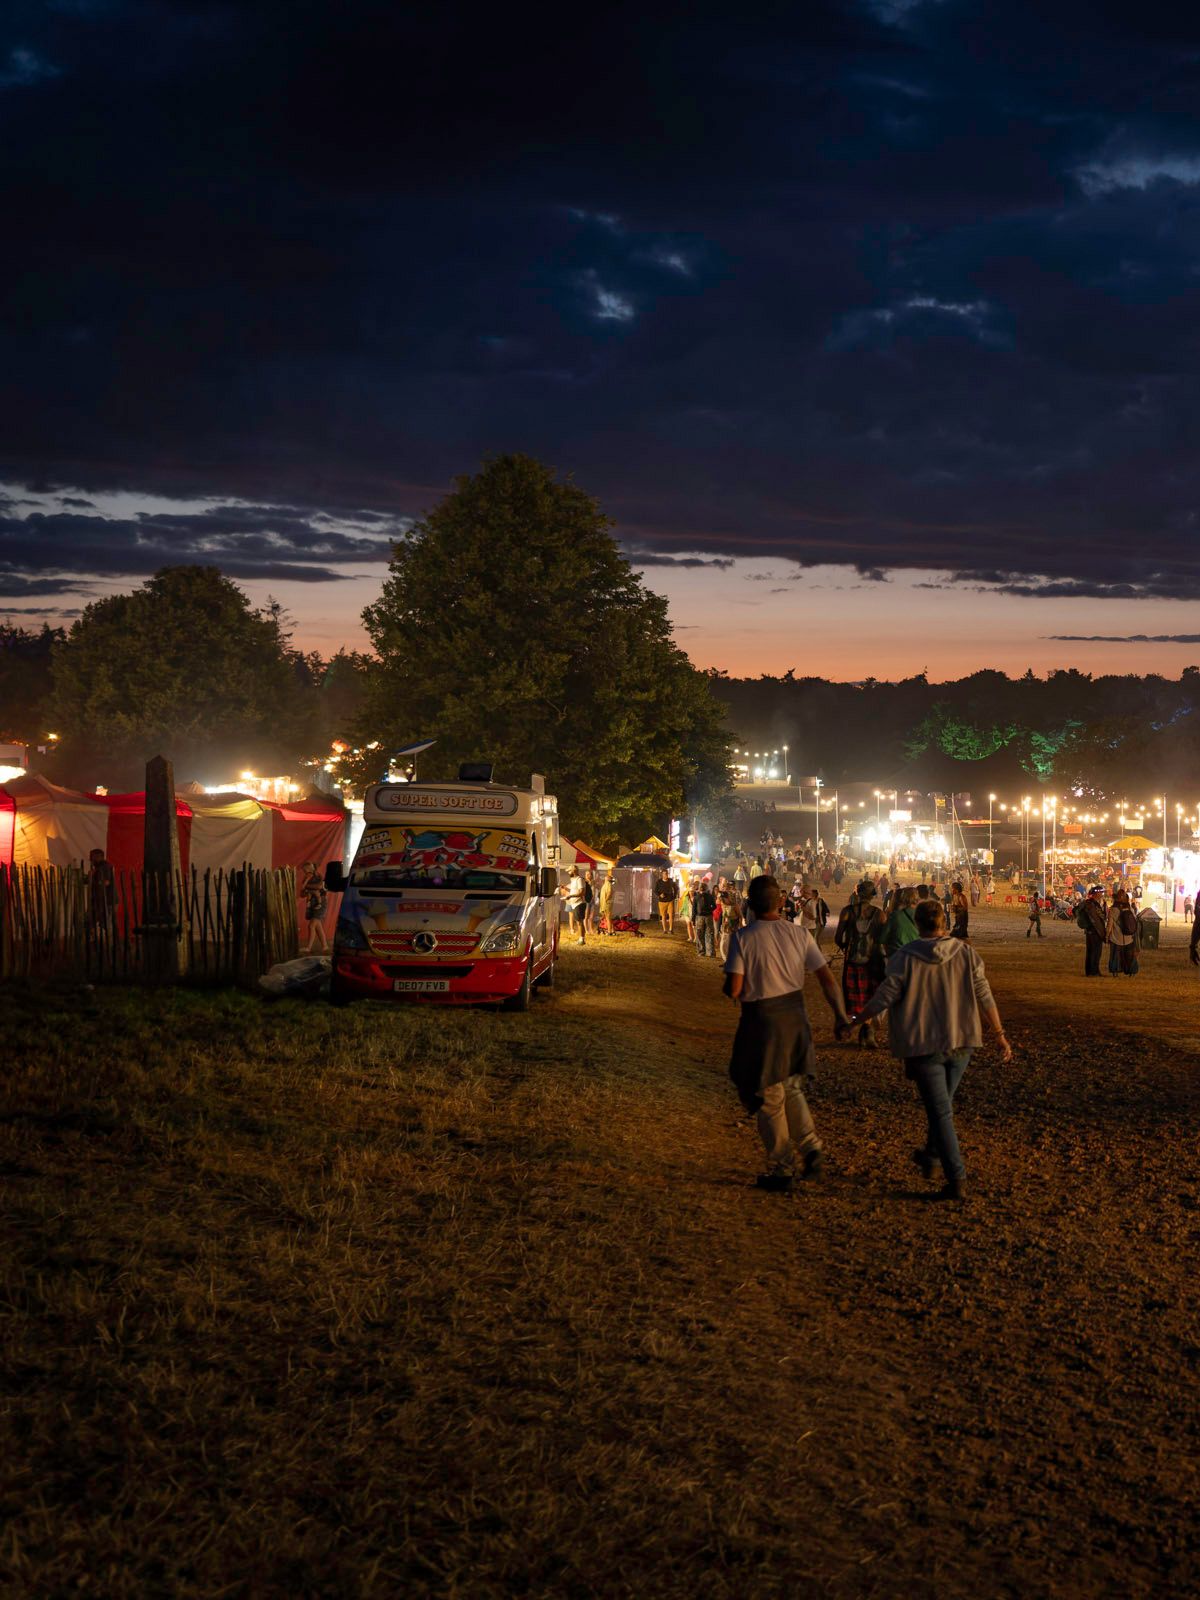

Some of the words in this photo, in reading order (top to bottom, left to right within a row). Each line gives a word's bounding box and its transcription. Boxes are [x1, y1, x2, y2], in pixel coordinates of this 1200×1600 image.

[391, 793, 437, 807] SUPER
[438, 795, 478, 809] SOFT
[479, 797, 504, 810] ICE
[502, 834, 529, 849] SOL
[356, 848, 530, 872] SLUSH
[398, 981, 424, 991] DE07
[426, 981, 446, 991] FVB
